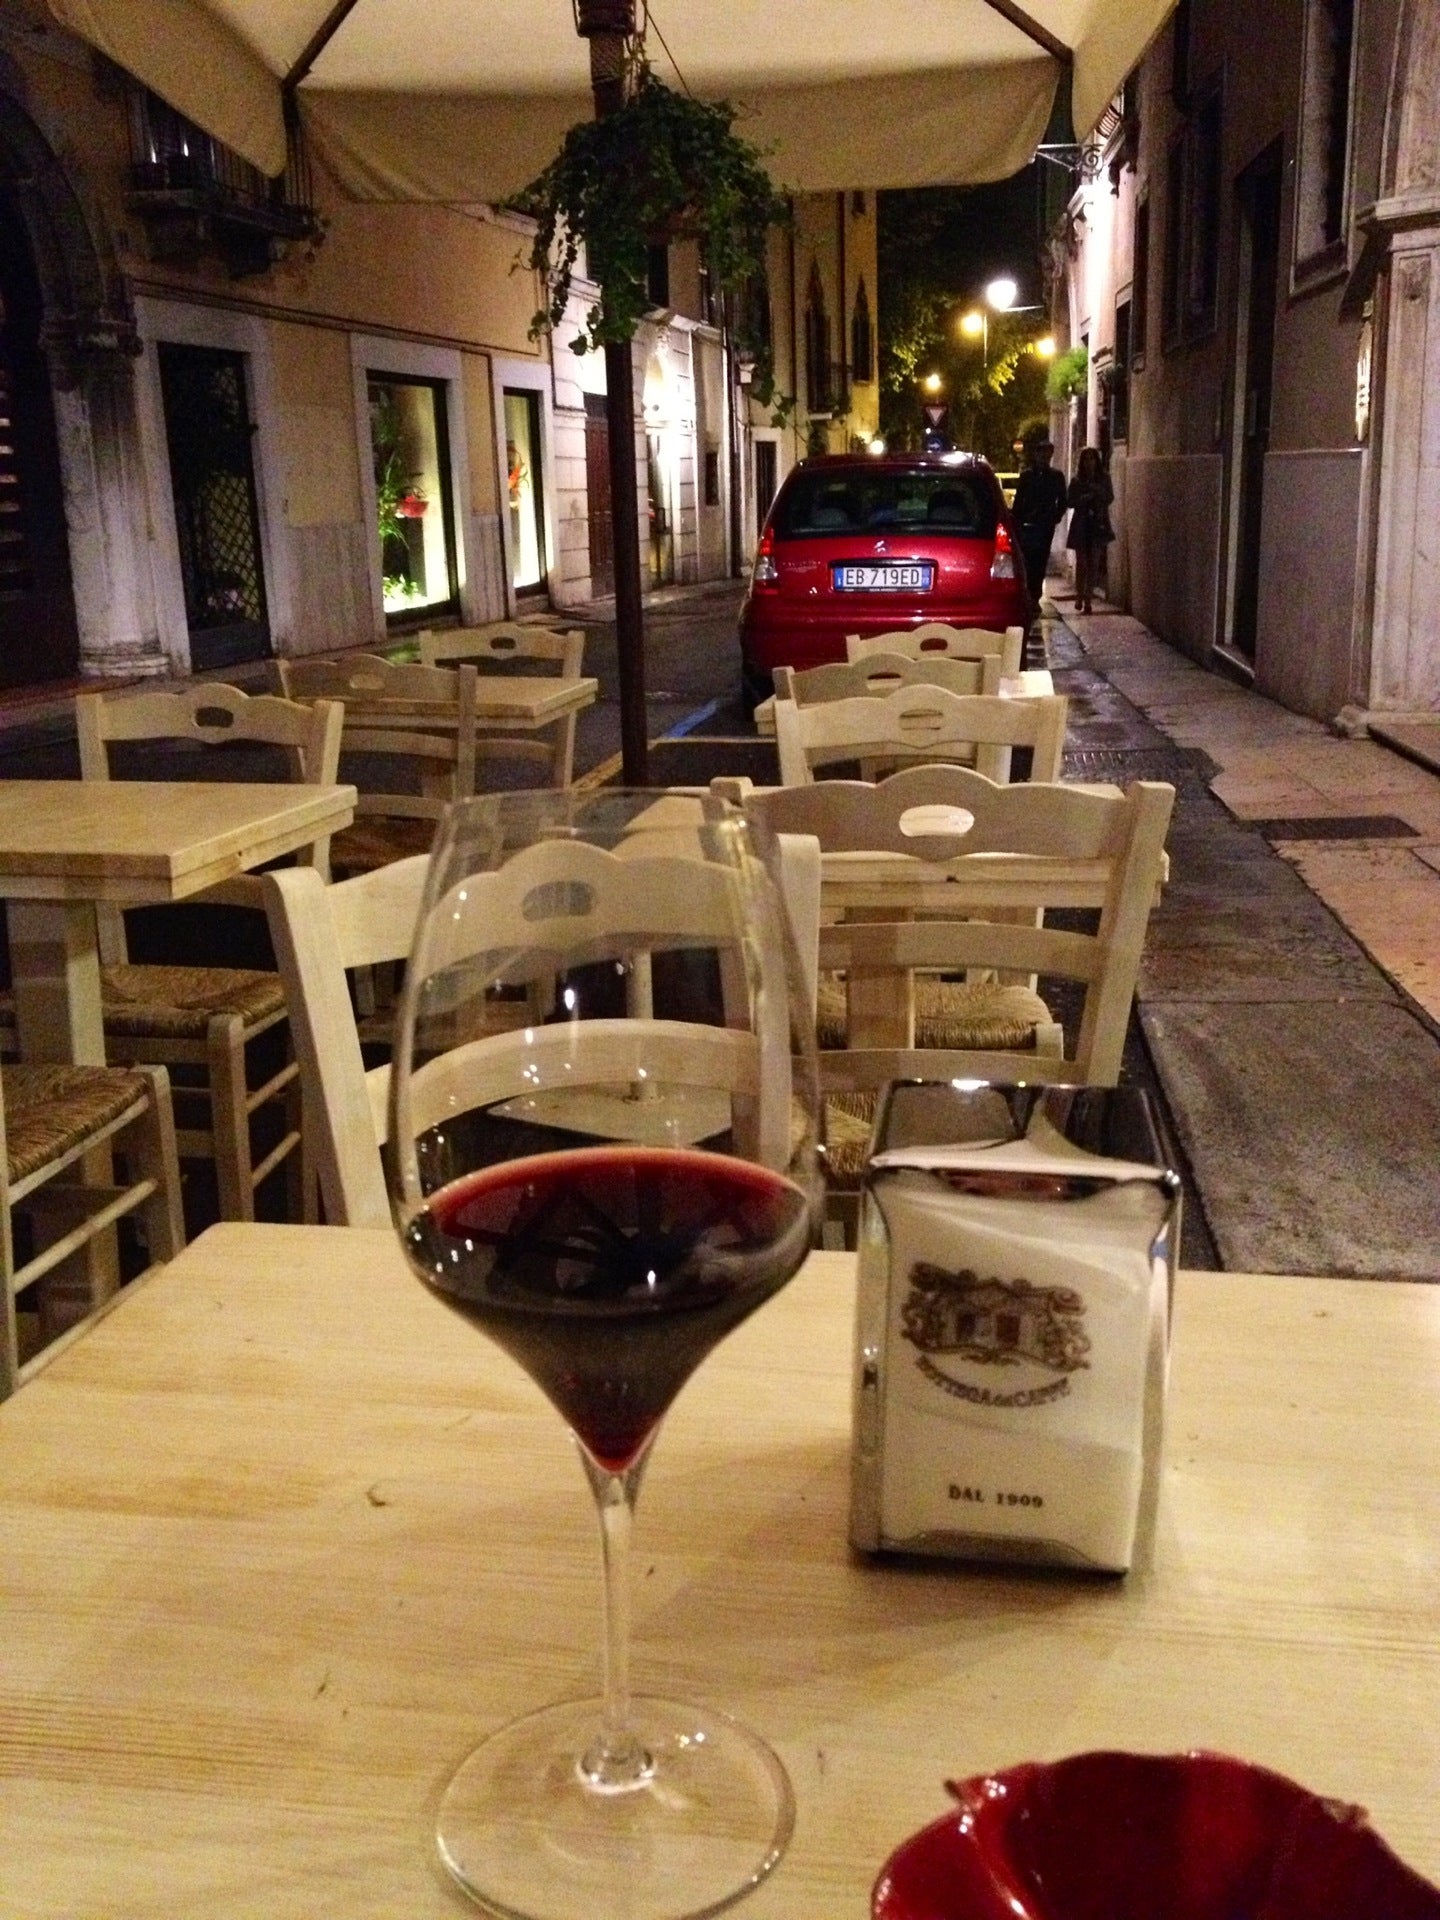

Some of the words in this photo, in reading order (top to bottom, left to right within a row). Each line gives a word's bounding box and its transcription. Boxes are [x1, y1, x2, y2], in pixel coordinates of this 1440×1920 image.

[846, 569, 864, 585] EB
[870, 569, 920, 585] 719ED
[948, 1484, 984, 1503] DAL
[997, 1492, 1043, 1508] 1909
